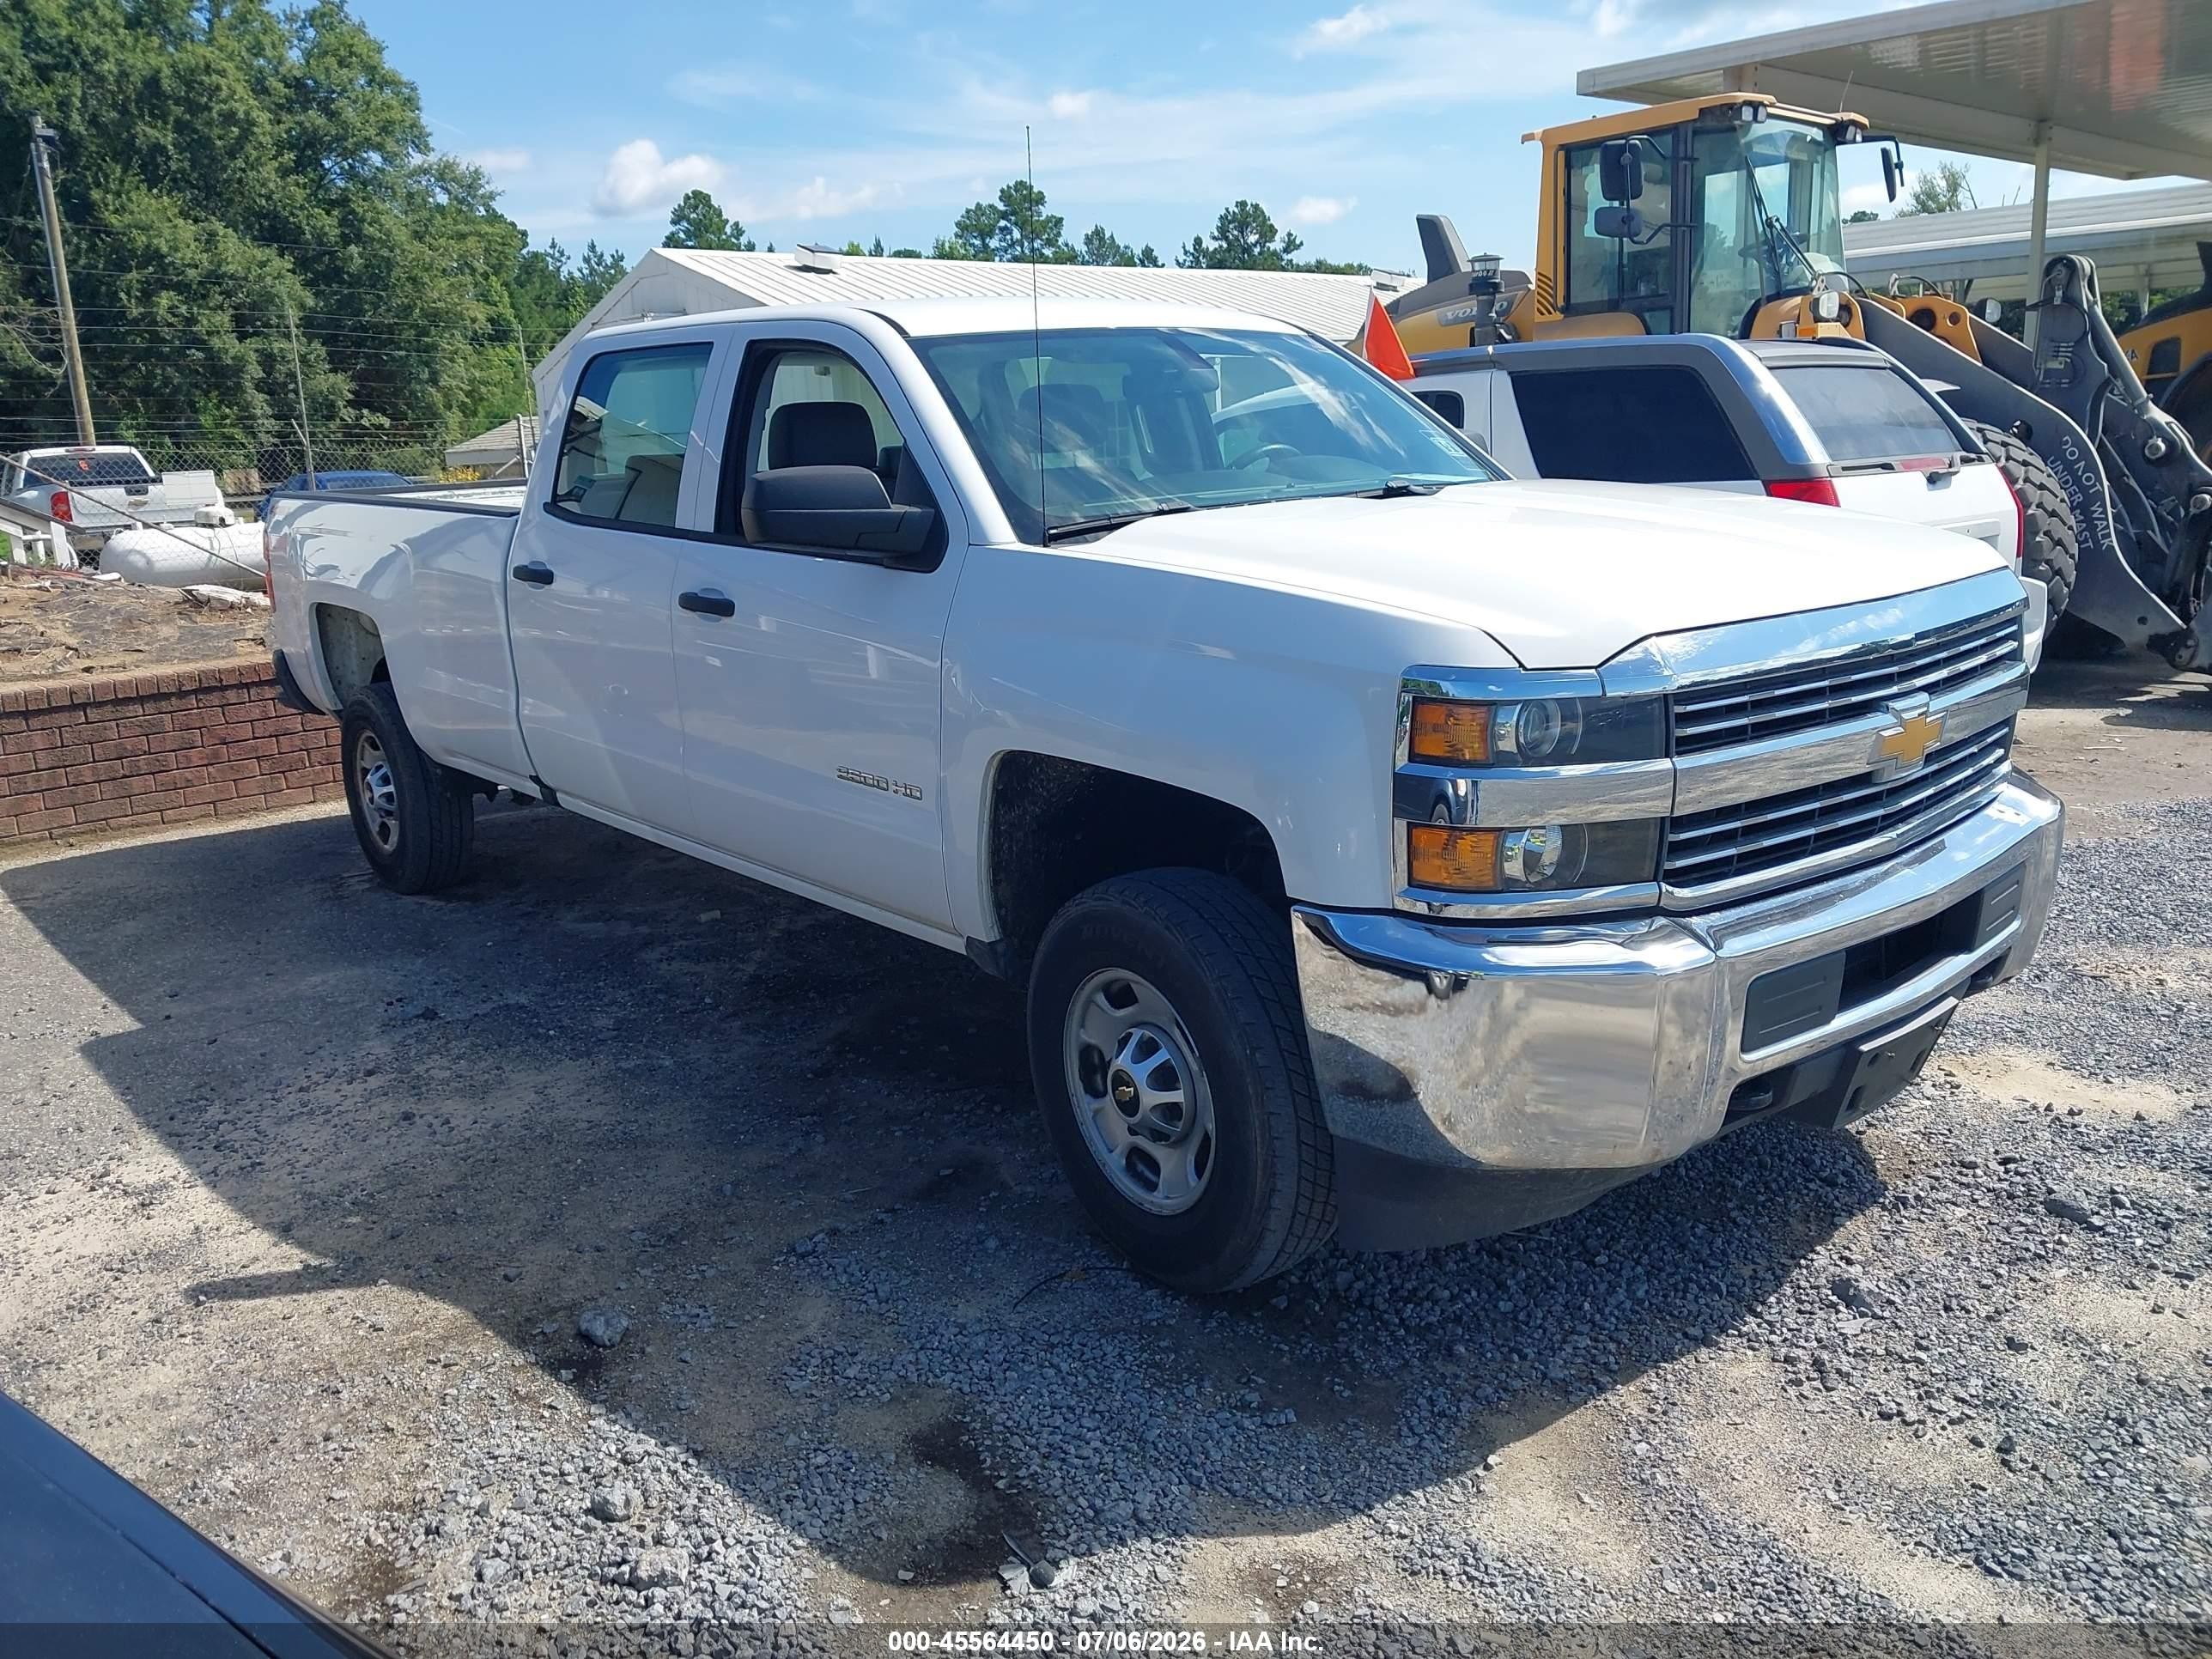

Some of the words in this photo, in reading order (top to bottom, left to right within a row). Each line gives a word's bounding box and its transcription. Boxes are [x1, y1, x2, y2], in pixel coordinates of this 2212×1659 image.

[2046, 456, 2083, 507] UNDER
[2072, 509, 2094, 549] MAST
[2062, 435, 2079, 460] DO
[2074, 460, 2103, 494] NOT
[2090, 501, 2114, 550] WALK
[836, 765, 889, 792] 2500
[892, 780, 923, 800] HD
